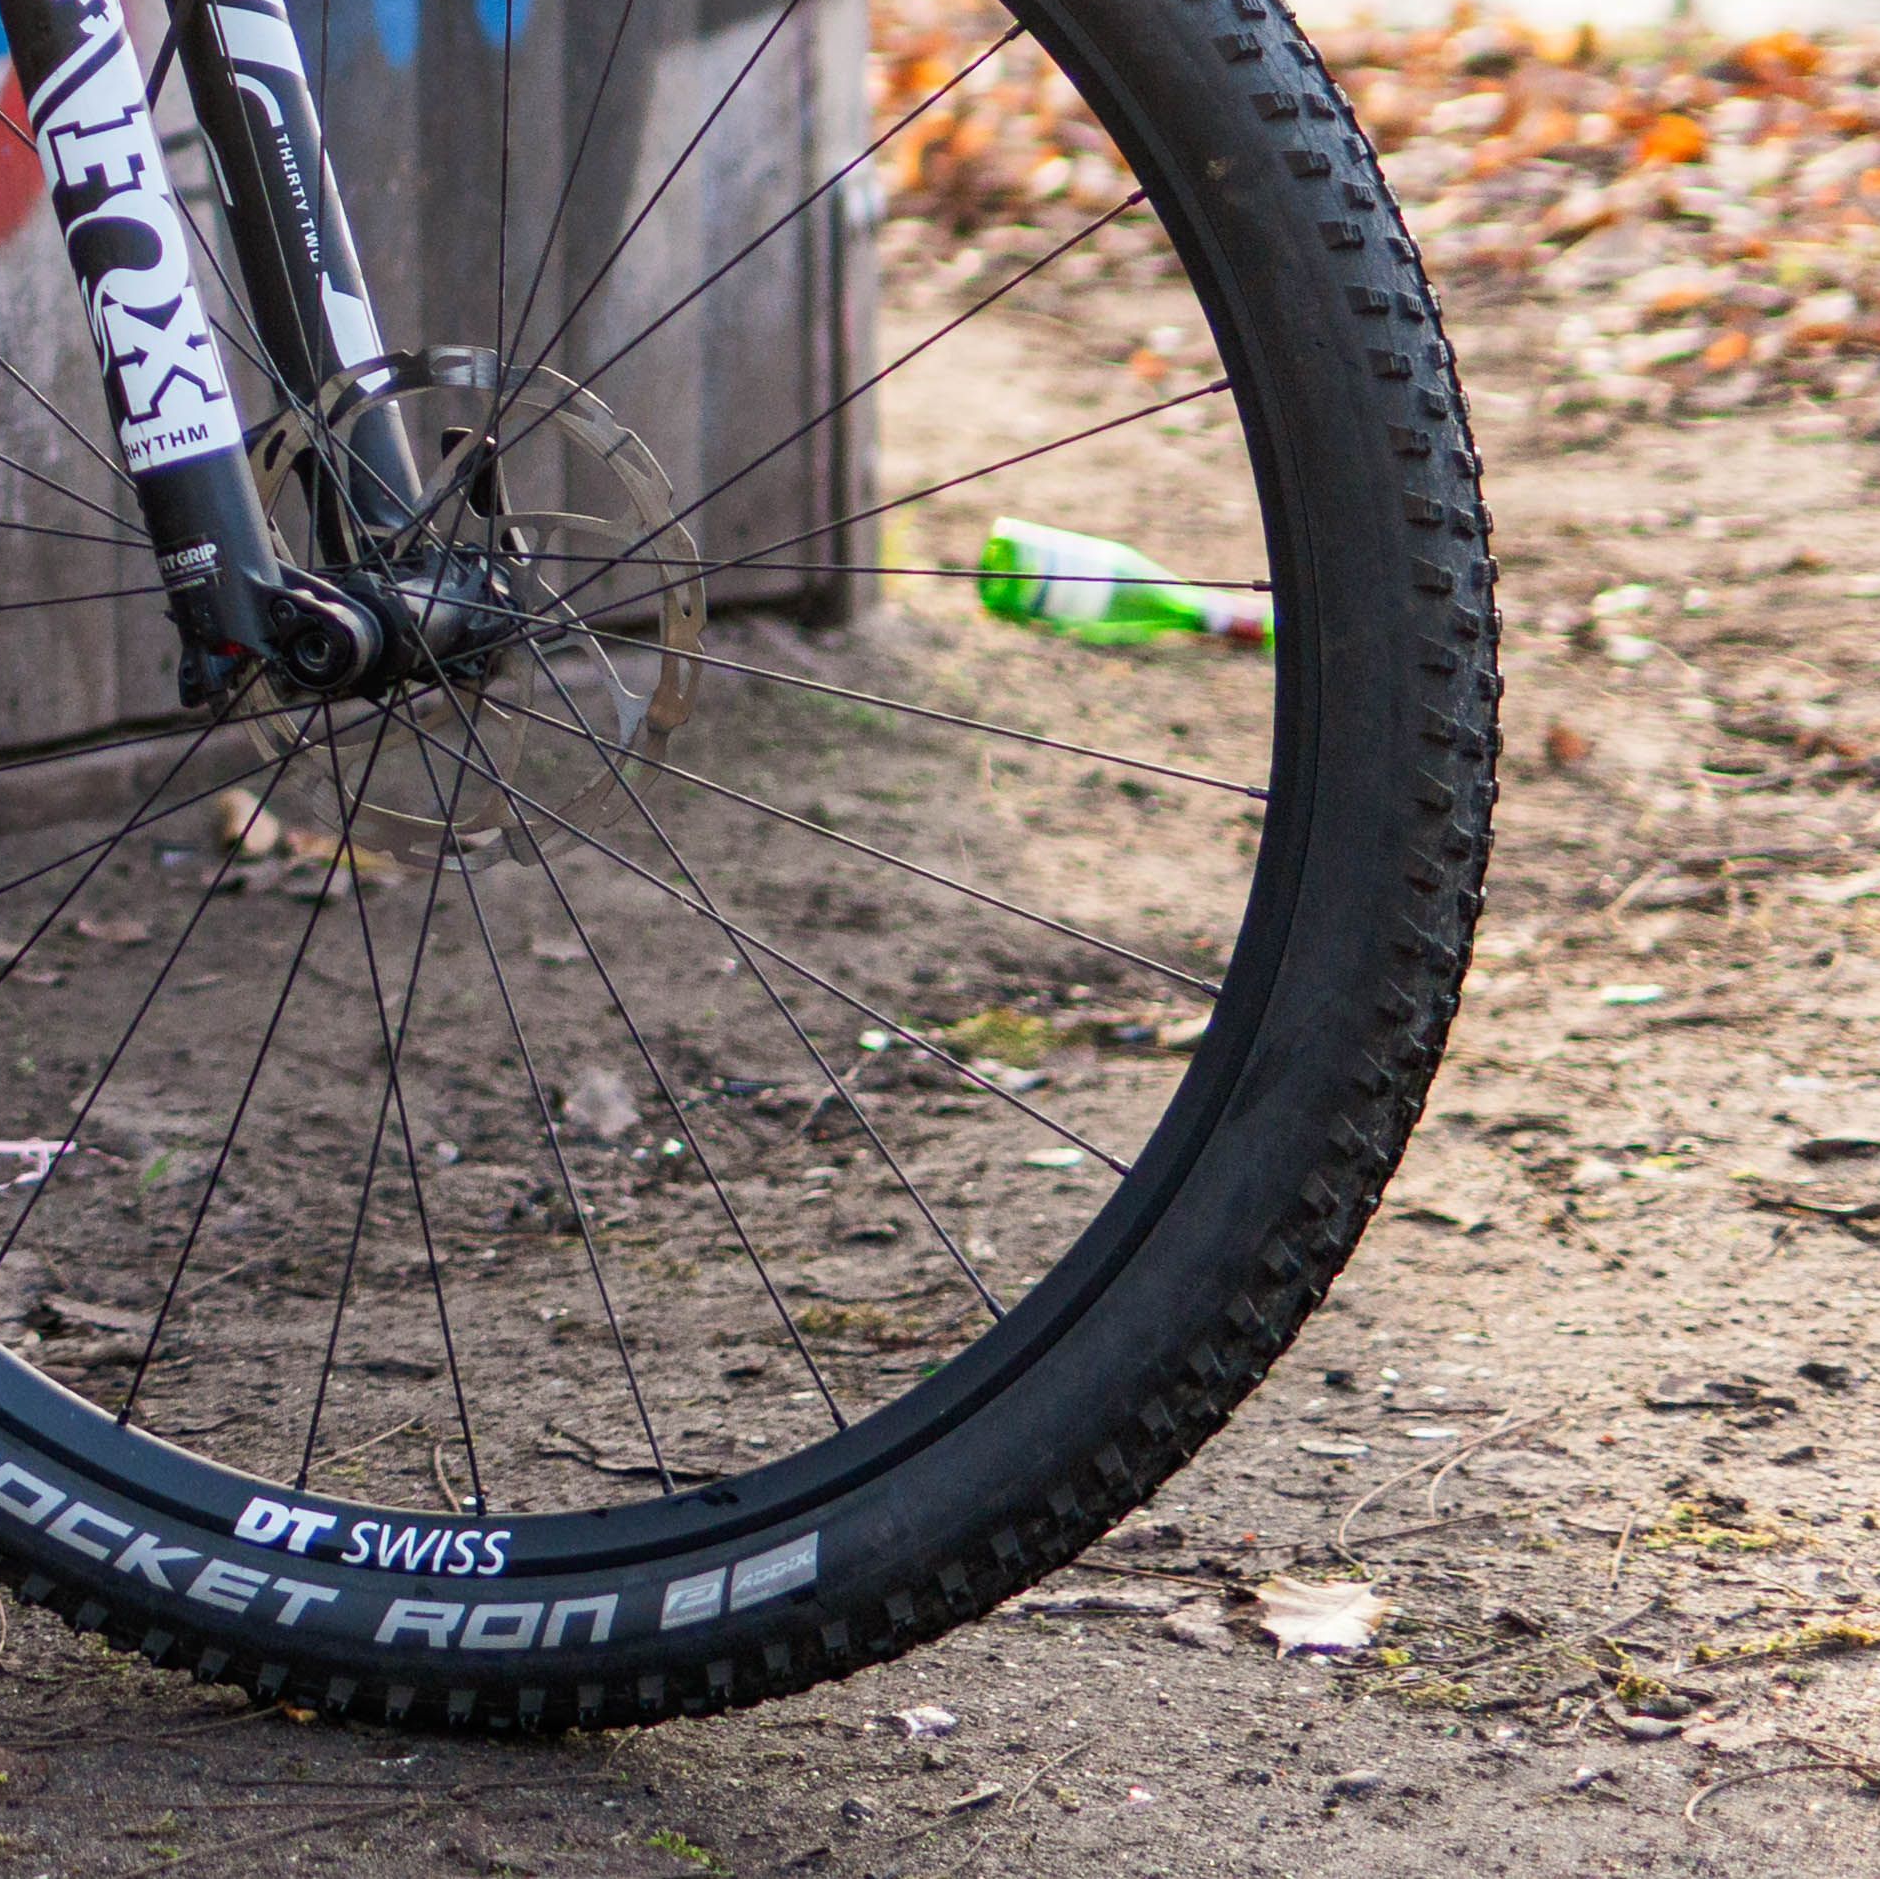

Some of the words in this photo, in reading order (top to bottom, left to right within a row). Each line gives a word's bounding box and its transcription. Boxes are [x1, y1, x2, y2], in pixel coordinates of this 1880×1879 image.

[275, 132, 311, 212] THIRTY
[48, 108, 231, 426] FOX
[123, 423, 210, 461] RHYTHM
[176, 542, 218, 567] GRIP
[234, 1496, 337, 1558] DT
[340, 1518, 512, 1577] SWISS
[374, 1594, 619, 1651] RON
